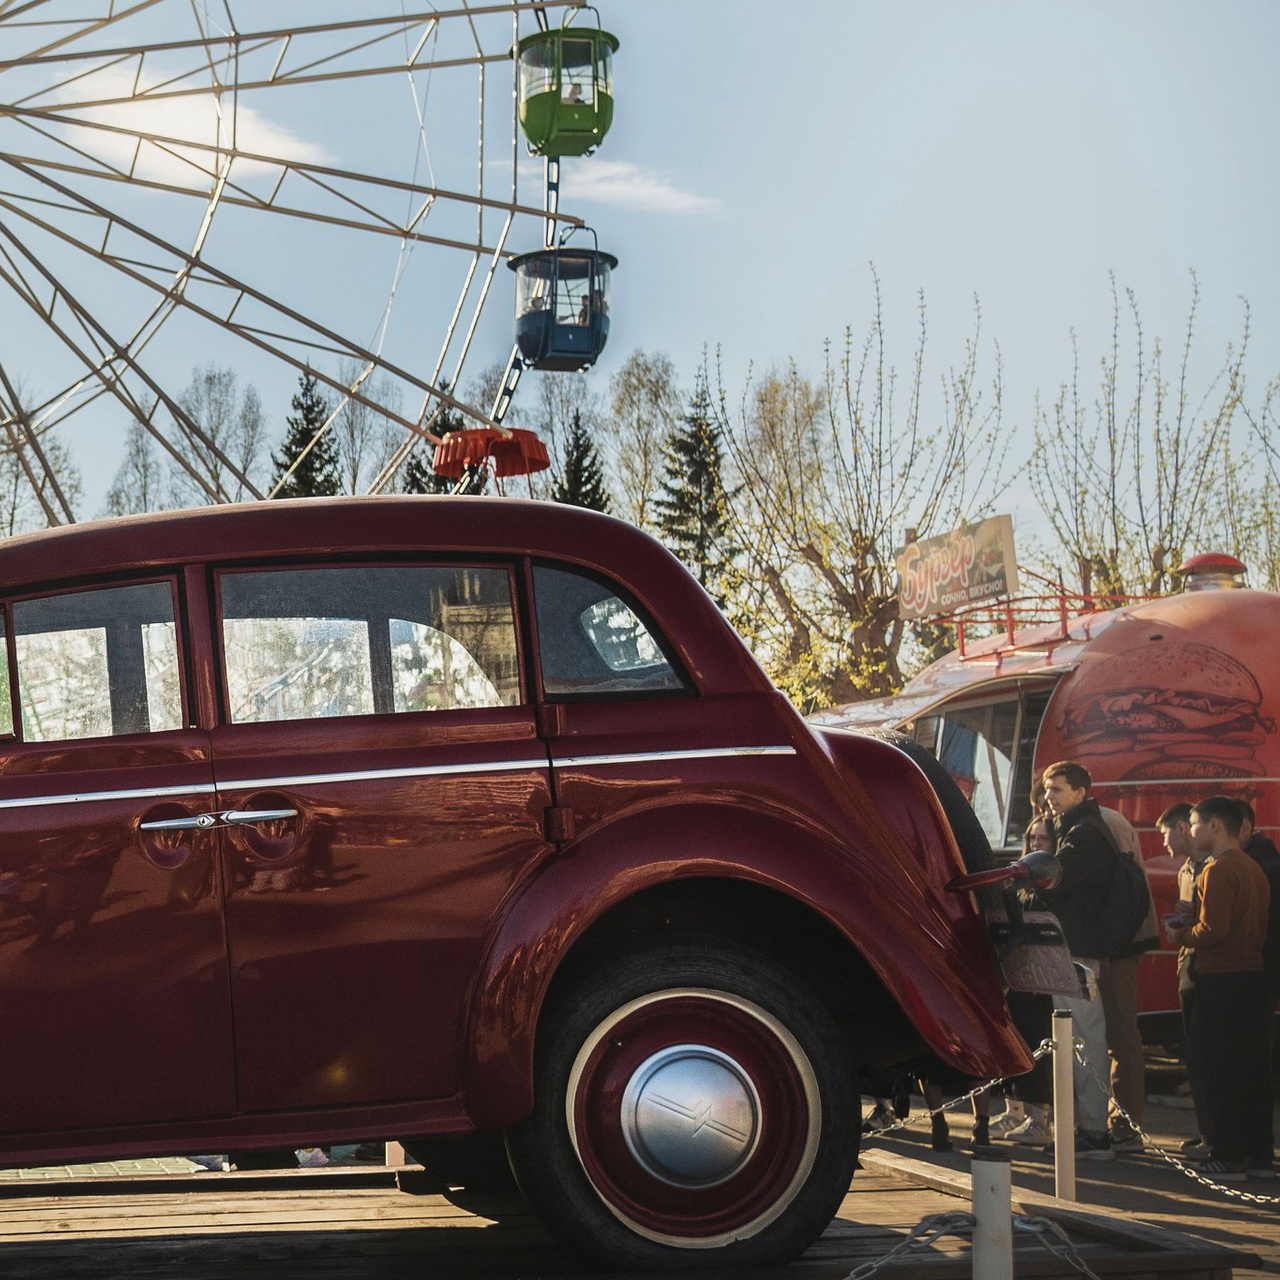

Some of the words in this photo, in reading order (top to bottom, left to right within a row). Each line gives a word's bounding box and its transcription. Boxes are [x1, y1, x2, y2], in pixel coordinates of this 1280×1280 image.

[897, 534, 975, 614] Бургер
[941, 590, 968, 605] СОЧНО,
[969, 579, 1003, 599] ВКУСНО!
